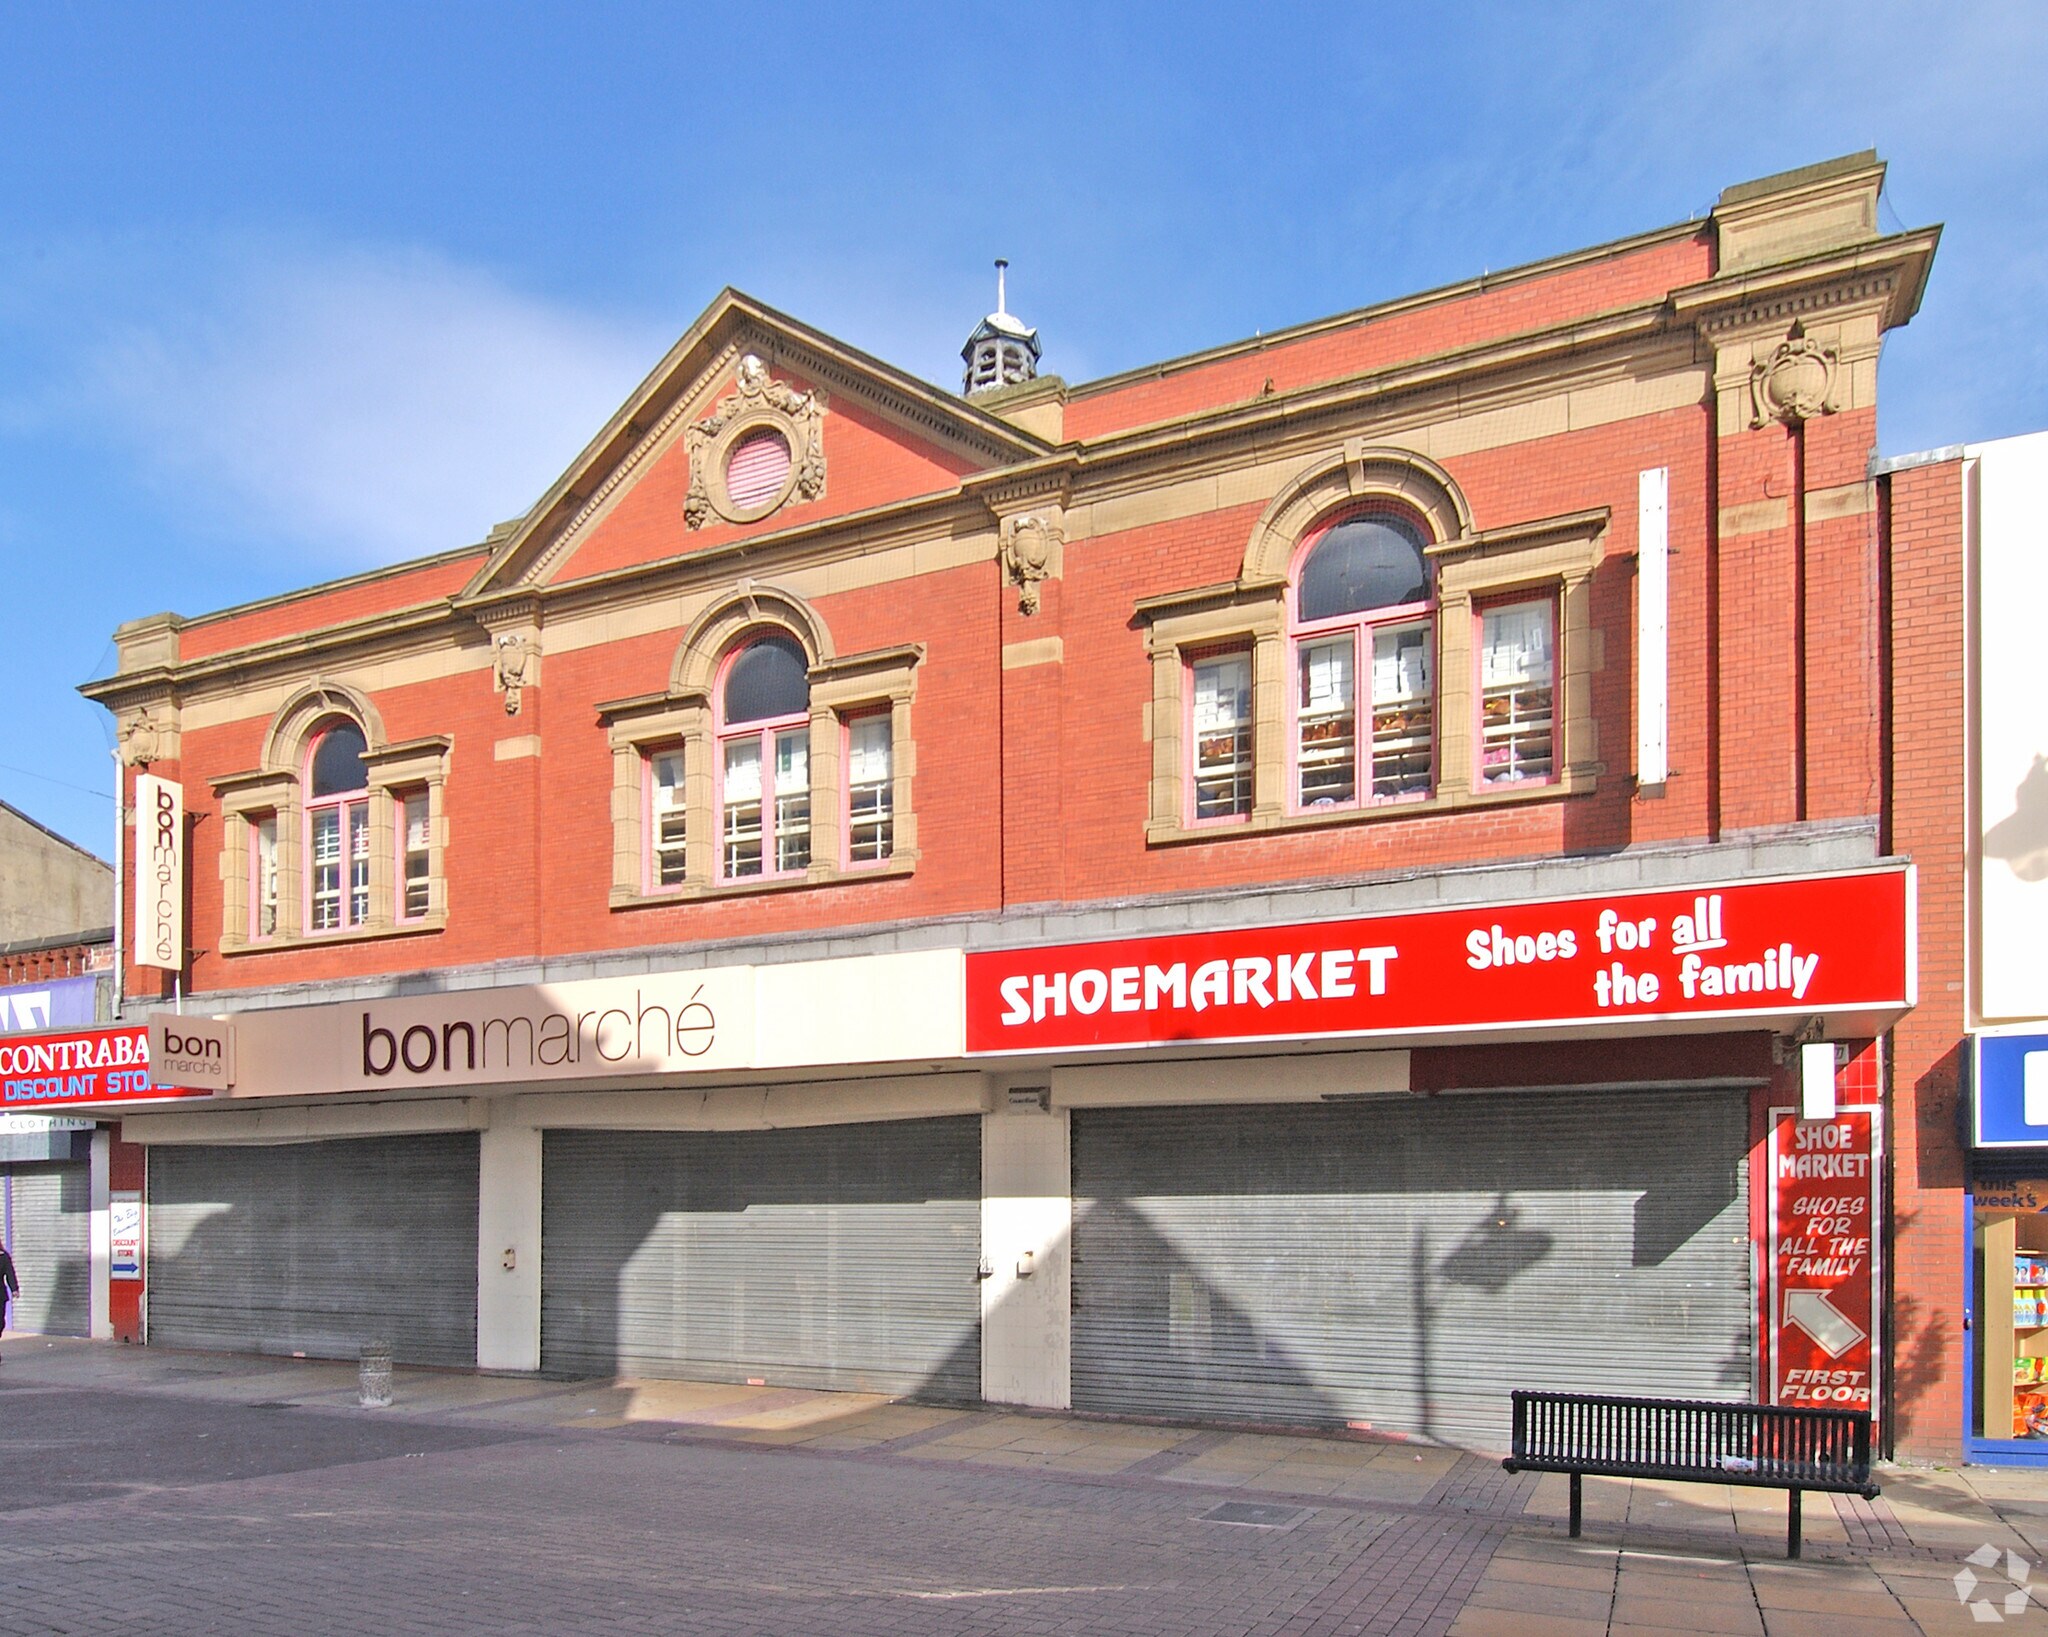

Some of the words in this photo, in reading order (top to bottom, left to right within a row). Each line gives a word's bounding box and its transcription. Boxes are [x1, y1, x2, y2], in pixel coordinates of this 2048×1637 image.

[1465, 924, 1578, 970] Shoes
[1595, 909, 1657, 954] for
[1671, 895, 1724, 945] all
[1000, 945, 1399, 1027] SHOEMARKET
[1593, 962, 1659, 1008] the
[1679, 943, 1820, 1000] family
[164, 1027, 221, 1058] bon
[164, 1059, 221, 1075] marché
[4, 1074, 97, 1101] DISCOUNT
[1795, 1124, 1853, 1152] SHOE
[1779, 1153, 1869, 1180] MARKET
[1792, 1197, 1866, 1216] SHOES
[1806, 1217, 1851, 1236] FOR
[1779, 1237, 1818, 1255] ALL
[1828, 1237, 1869, 1256] THE
[1786, 1257, 1861, 1277] FAMILY
[1786, 1369, 1866, 1385] FIRST
[1780, 1385, 1870, 1402] FLOOR
